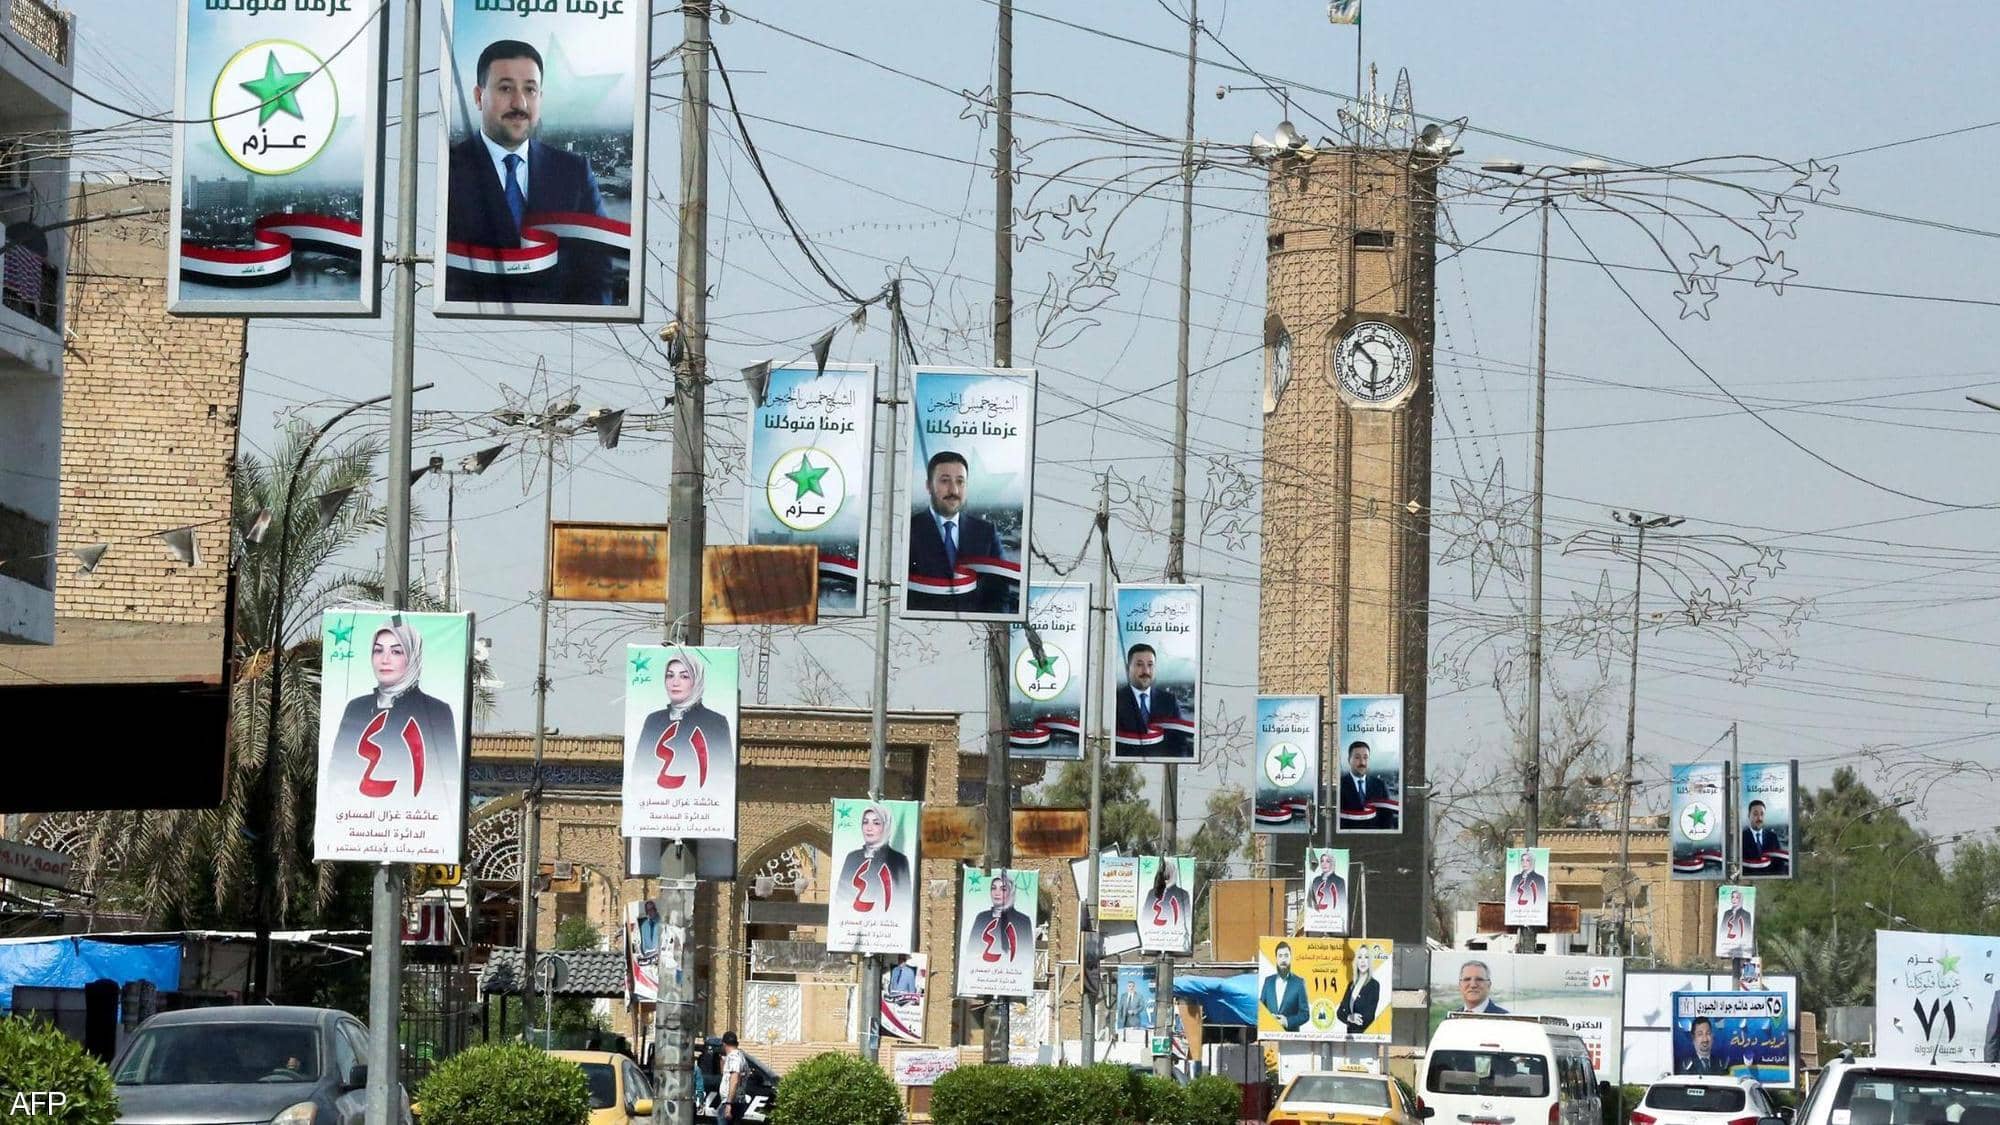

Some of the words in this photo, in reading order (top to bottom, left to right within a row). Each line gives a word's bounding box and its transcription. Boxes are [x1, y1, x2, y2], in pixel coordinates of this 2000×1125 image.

[243, 128, 306, 155] عزم
[764, 414, 815, 433] فتوكلنا
[819, 416, 855, 434] عزمنا
[926, 420, 977, 438] فتوكلنا
[982, 421, 1017, 439] عزمنا
[786, 501, 825, 518] عزم
[1052, 620, 1076, 632] عزمنا
[1126, 621, 1162, 634] فتوكلنا
[1165, 622, 1190, 634] عزمنا
[1028, 680, 1057, 692] عزم
[357, 709, 427, 798] ٤١
[655, 721, 710, 790] ٤١
[336, 809, 375, 823] المساري
[378, 809, 401, 822] غزال
[405, 808, 439, 821] عائشة
[349, 827, 390, 838] السادسة
[393, 828, 426, 840] الدائرة
[852, 859, 893, 913] ٤١
[1517, 879, 1538, 906] ٤١
[1316, 881, 1338, 910] ٤١
[1152, 895, 1180, 927] ٤١
[1727, 914, 1745, 939] ٤١
[982, 917, 1018, 963] ٤١
[1907, 953, 1934, 966] عزم
[1315, 976, 1337, 993] ١١٩
[1766, 997, 1781, 1014] ٢٥
[1572, 1020, 1602, 1031] الدكتور
[1913, 997, 1956, 1043] ٧١
